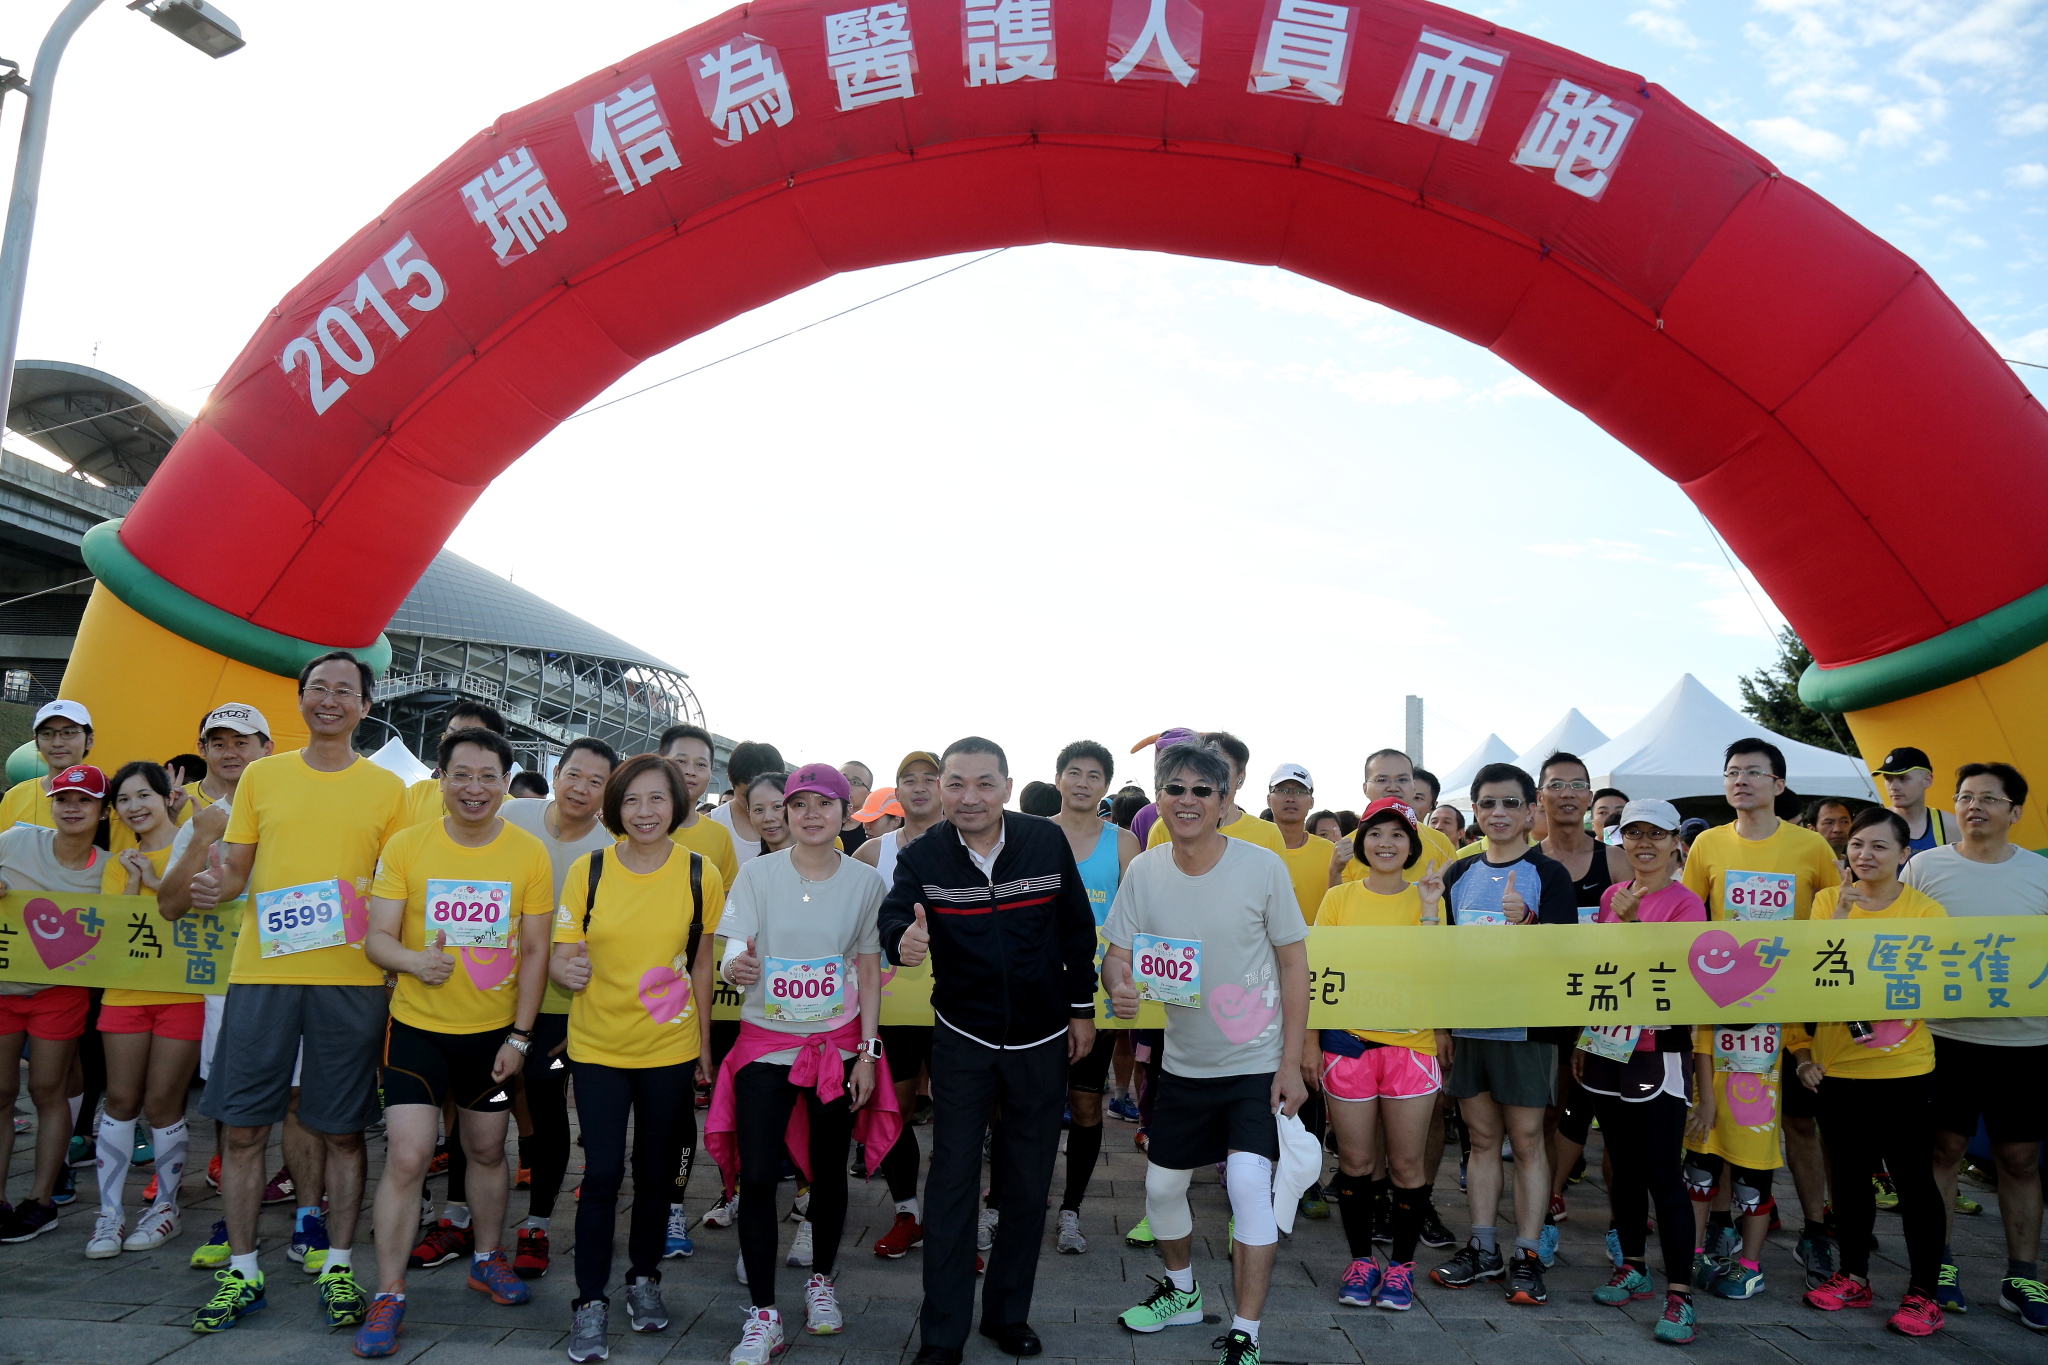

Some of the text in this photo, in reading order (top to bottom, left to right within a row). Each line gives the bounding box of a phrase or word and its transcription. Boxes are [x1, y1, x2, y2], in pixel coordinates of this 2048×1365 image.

[282, 0, 1636, 416] 2015 瑞信為醫護人員而跑
[320, 890, 332, 899] 5K
[1731, 887, 1787, 908] 8120
[268, 902, 333, 933] 5599
[433, 900, 501, 924] 8020
[1184, 949, 1195, 957] 8K
[1140, 954, 1193, 982] 8002
[1245, 962, 1272, 988] 瑞信
[772, 976, 836, 999] 8006
[1566, 961, 1677, 1012] 瑞信
[1721, 1033, 1775, 1054] 8118
[679, 1147, 691, 1176] SKINS
